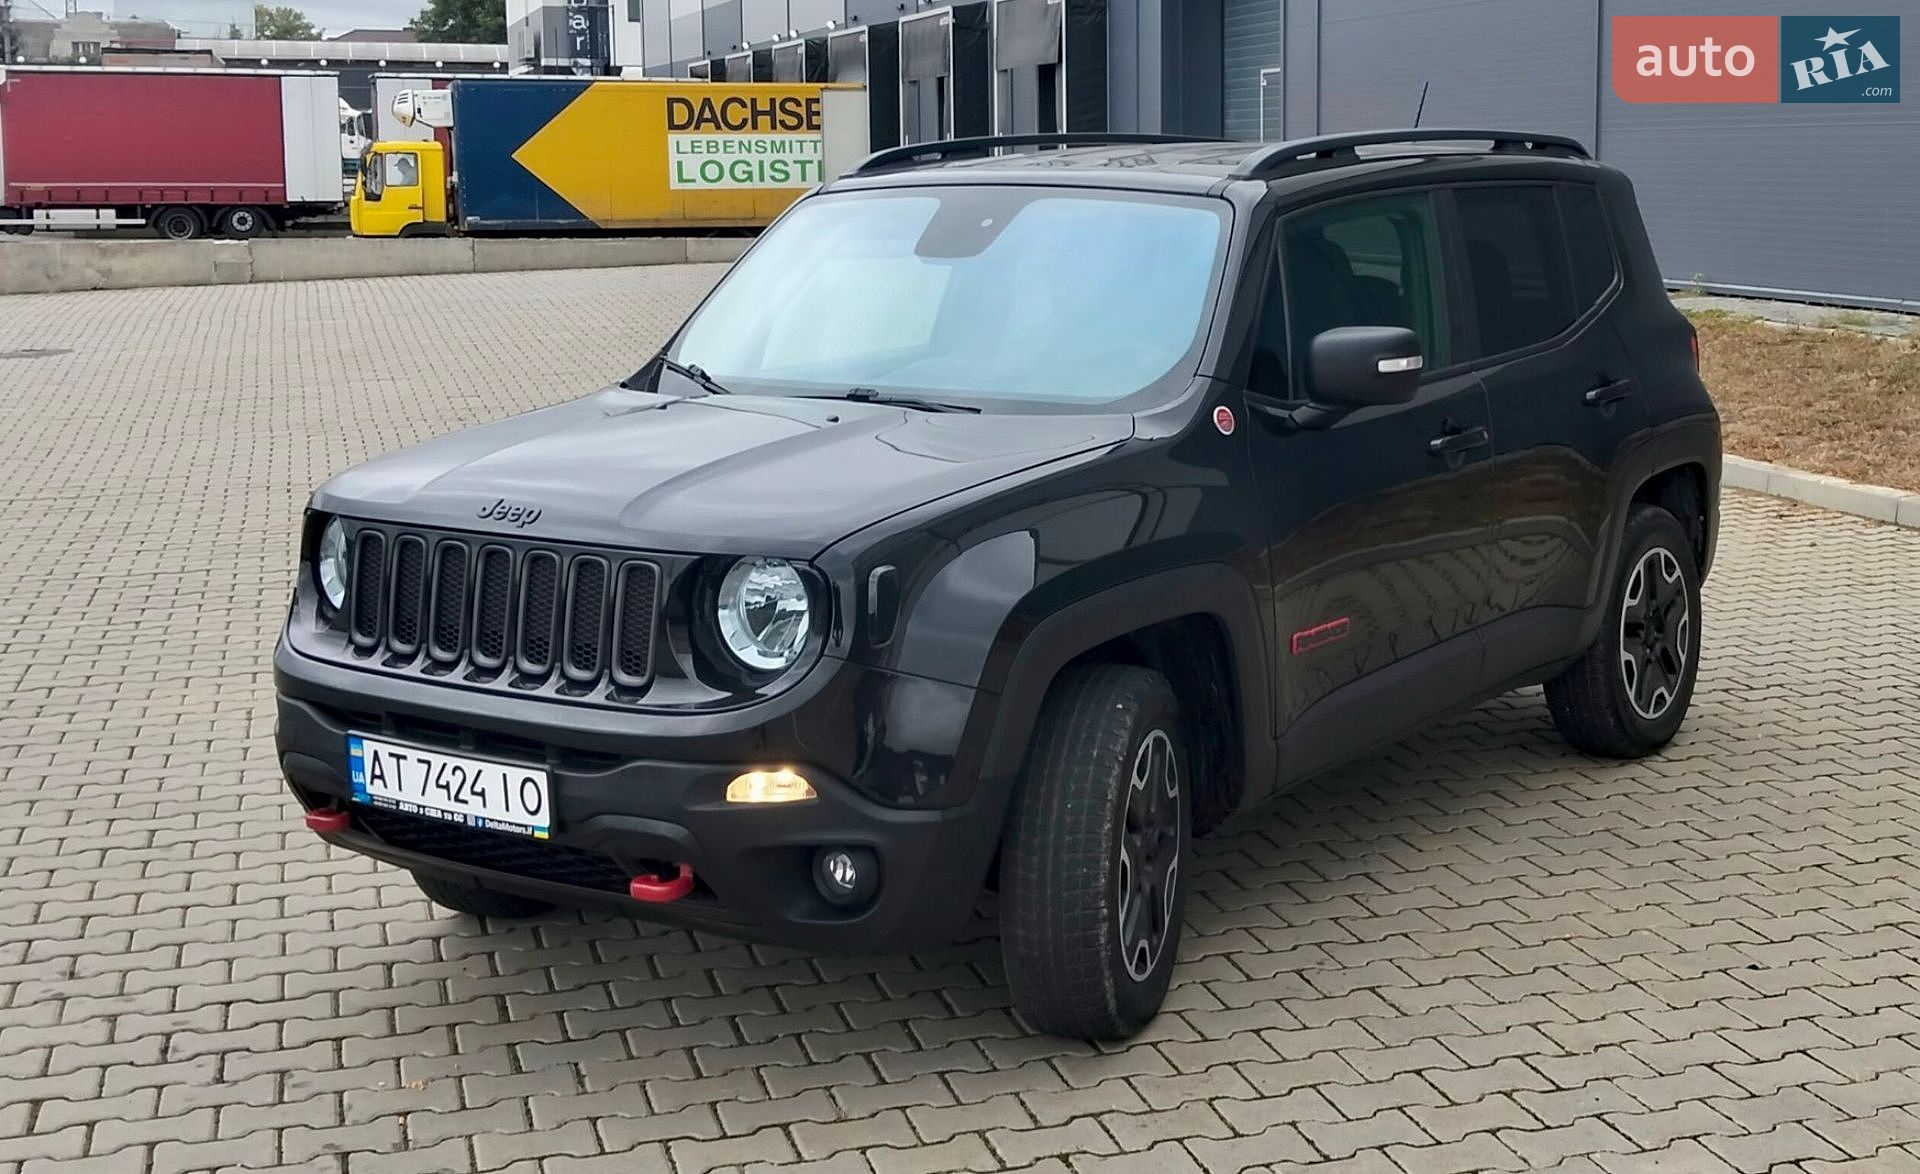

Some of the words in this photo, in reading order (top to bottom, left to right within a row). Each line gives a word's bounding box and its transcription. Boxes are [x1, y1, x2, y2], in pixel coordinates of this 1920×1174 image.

[676, 139, 822, 154] LEBENSMITT
[677, 159, 823, 184] LOGISTI
[477, 498, 542, 528] Jeep
[352, 770, 365, 785] UA
[370, 749, 408, 792] AT
[416, 758, 487, 809] 7424
[502, 772, 543, 817] IO
